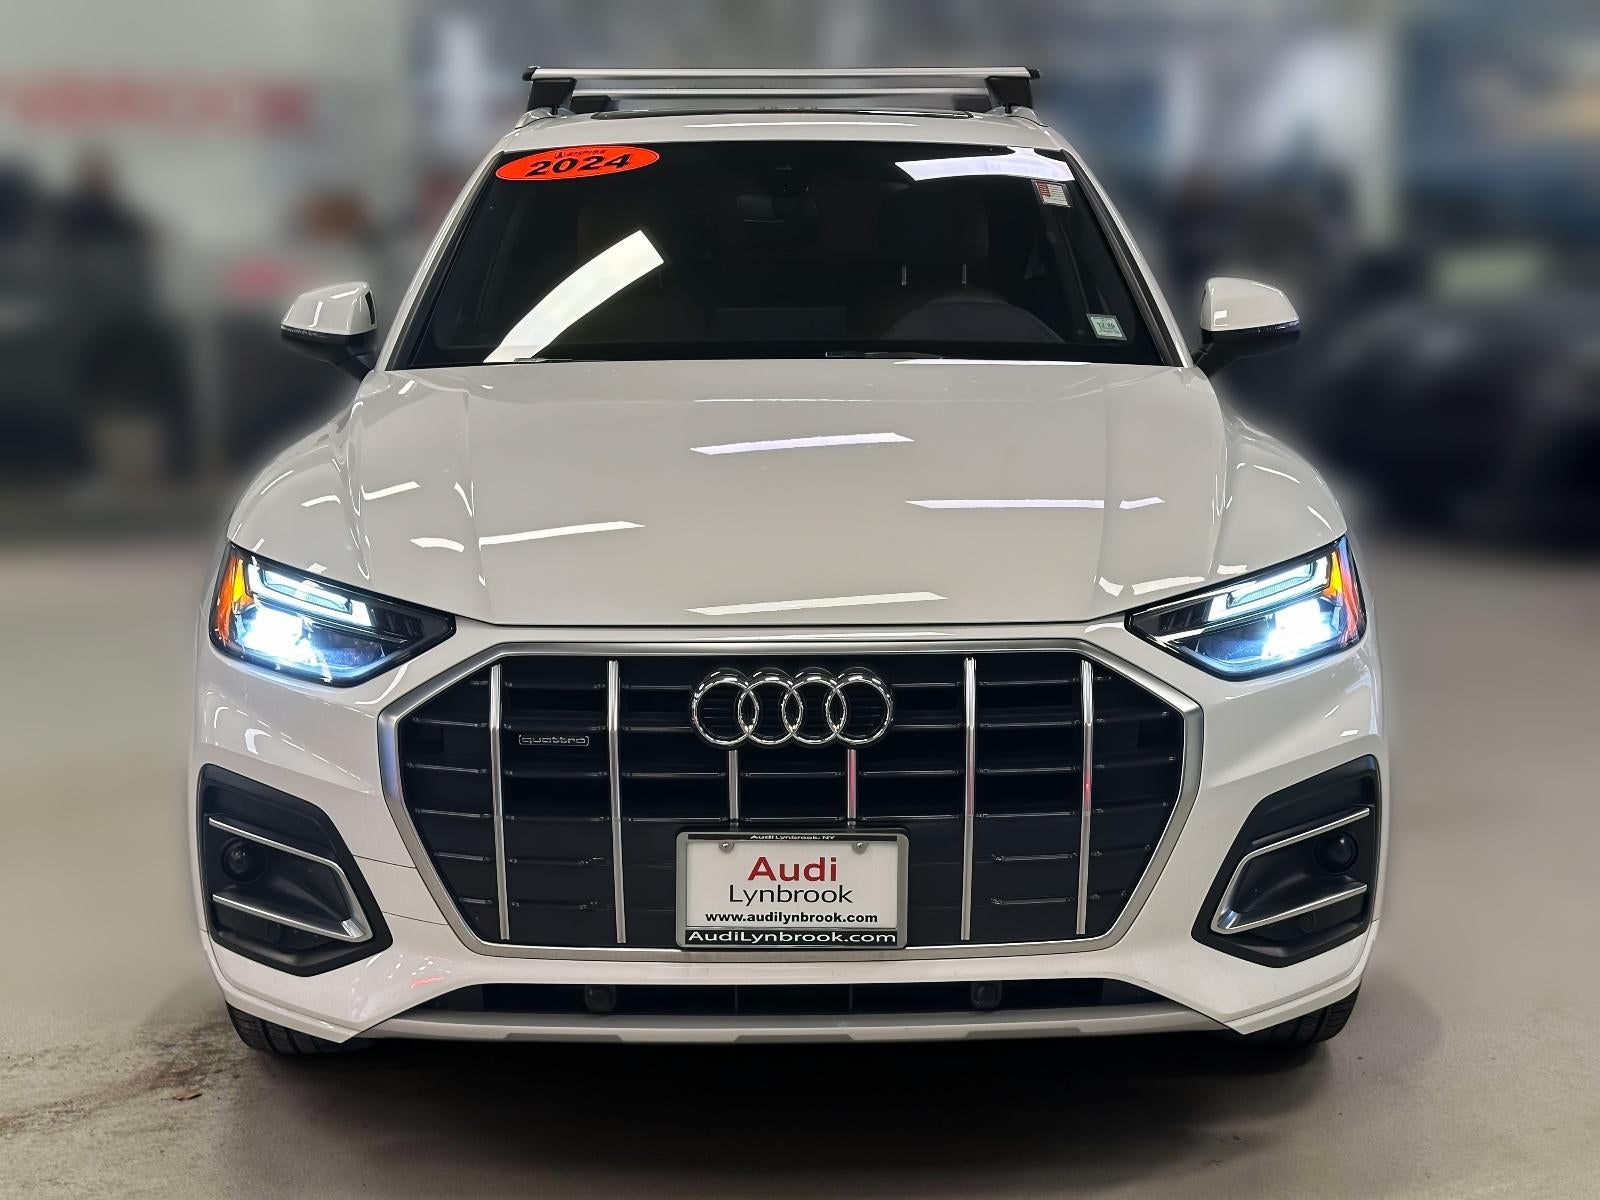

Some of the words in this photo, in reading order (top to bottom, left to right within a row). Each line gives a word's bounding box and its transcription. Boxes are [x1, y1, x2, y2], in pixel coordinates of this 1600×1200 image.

[524, 153, 632, 177] 2024
[521, 736, 586, 744] quattro
[747, 856, 837, 882] Audi
[729, 885, 853, 906] Lynbrook
[705, 911, 878, 925] www.audilynbrook.com
[688, 931, 896, 944] AudiLynbrook.com
